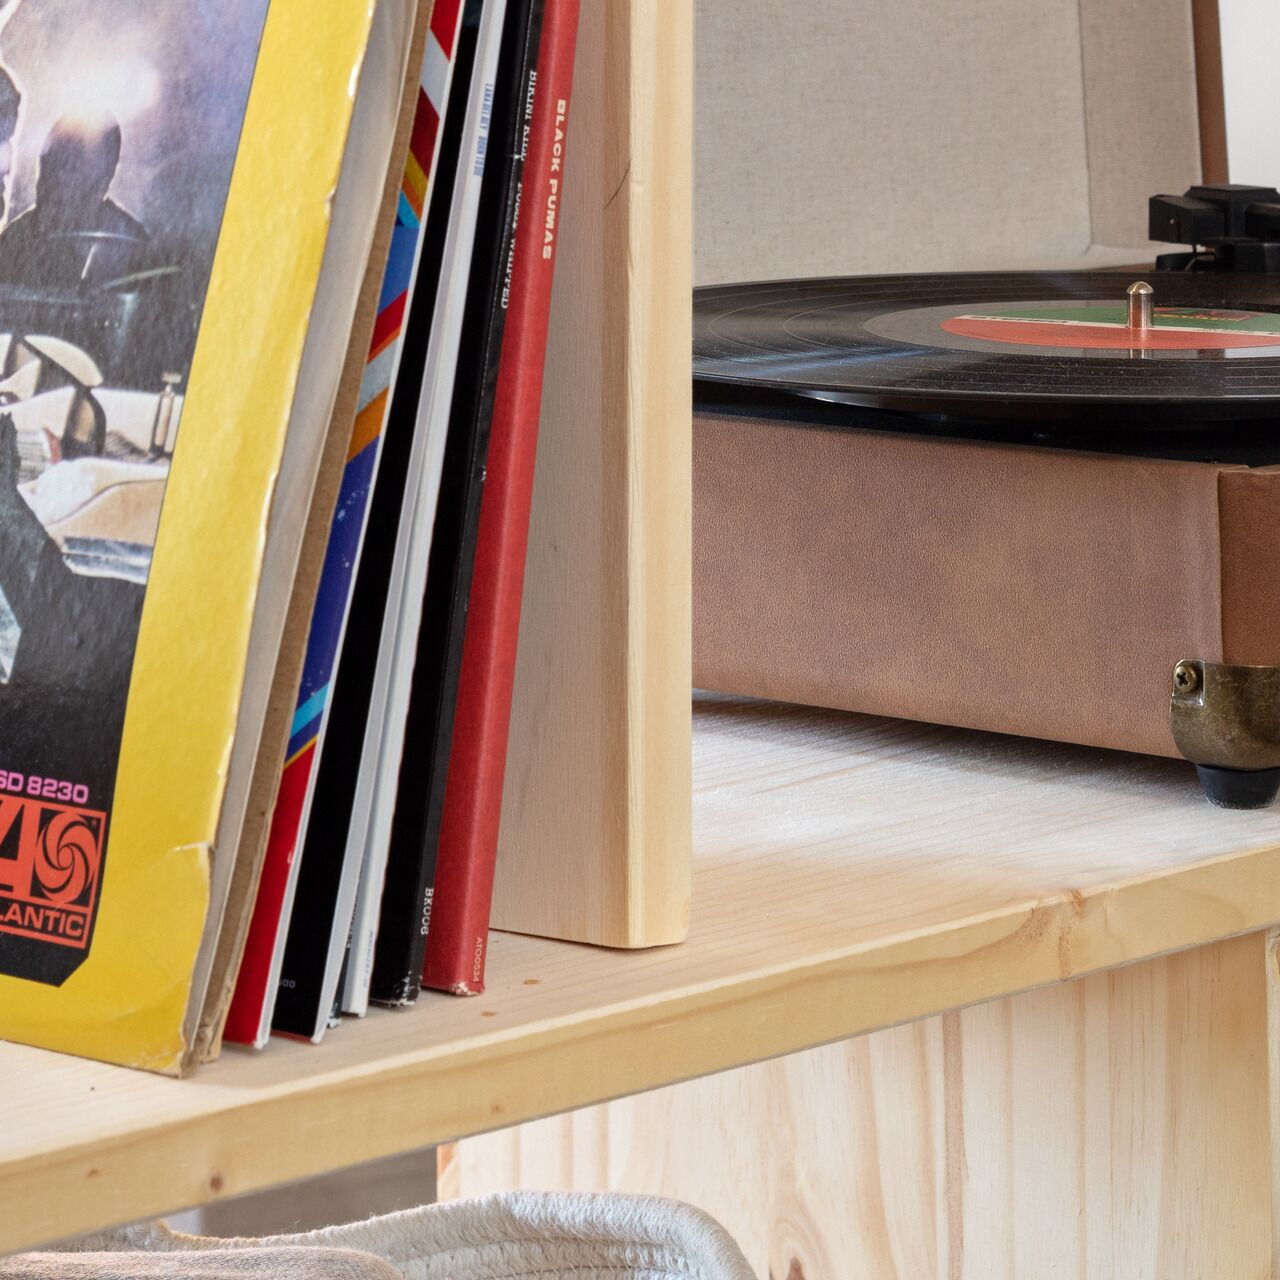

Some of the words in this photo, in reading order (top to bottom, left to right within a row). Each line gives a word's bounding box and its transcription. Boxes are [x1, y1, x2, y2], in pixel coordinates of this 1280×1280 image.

[550, 99, 567, 172] BLACK
[542, 178, 559, 260] PUMAS
[27, 776, 89, 804] 8230
